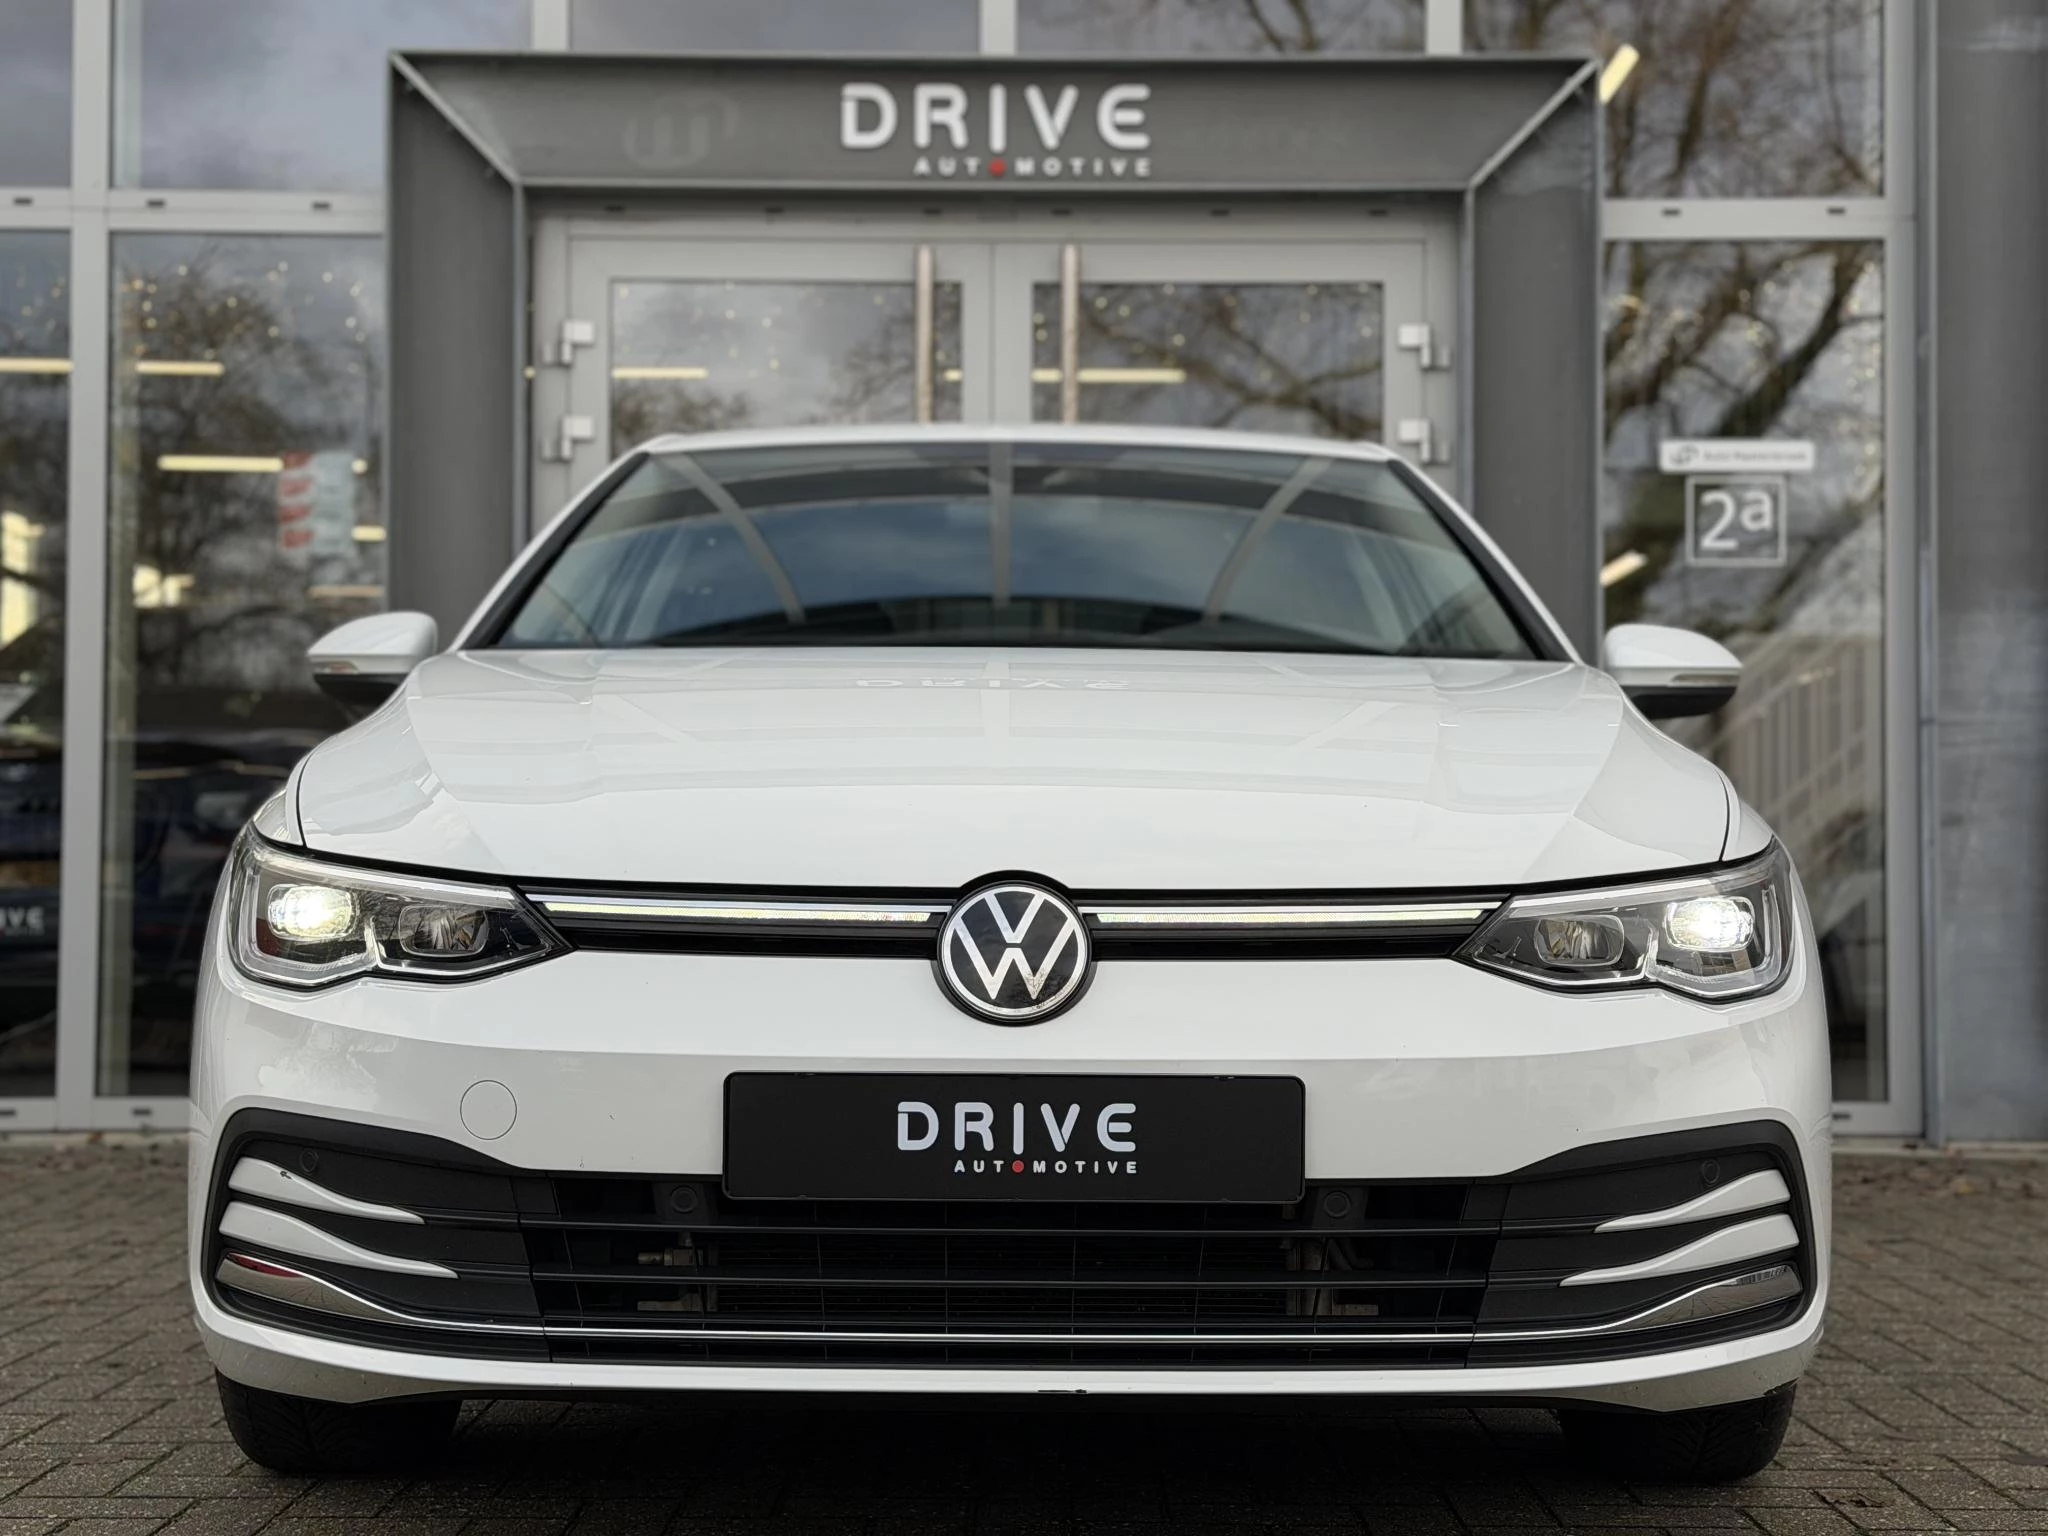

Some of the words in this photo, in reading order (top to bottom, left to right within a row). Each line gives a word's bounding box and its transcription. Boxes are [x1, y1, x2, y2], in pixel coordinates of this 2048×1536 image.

[841, 82, 1151, 153] DRIVE
[913, 156, 1152, 177] AUTOMOTIVE
[1701, 489, 1774, 549] 2a
[948, 888, 1079, 1003] VW
[897, 1101, 1137, 1155] DRIVE
[954, 1160, 1138, 1174] AUTOMOTIVE
